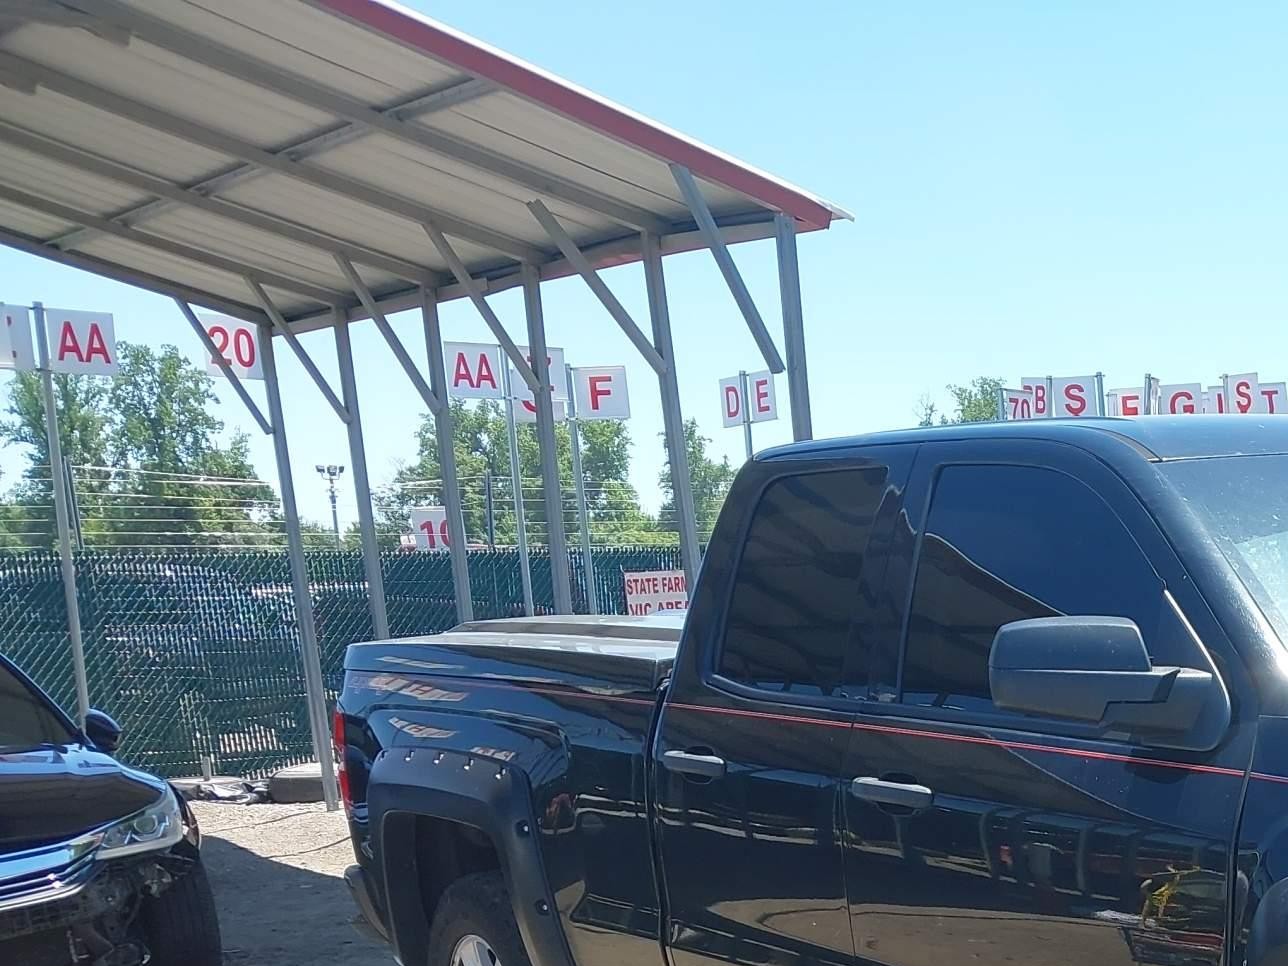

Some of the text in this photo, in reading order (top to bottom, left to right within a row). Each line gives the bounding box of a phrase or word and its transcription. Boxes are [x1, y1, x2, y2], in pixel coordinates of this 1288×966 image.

[58, 320, 111, 364] AA
[208, 326, 255, 368] 20
[454, 352, 497, 389] AA
[588, 375, 612, 411] F
[725, 386, 740, 418] D
[756, 379, 770, 413] E
[1064, 384, 1086, 416] S
[1236, 381, 1252, 414] S
[627, 577, 659, 595] STATE
